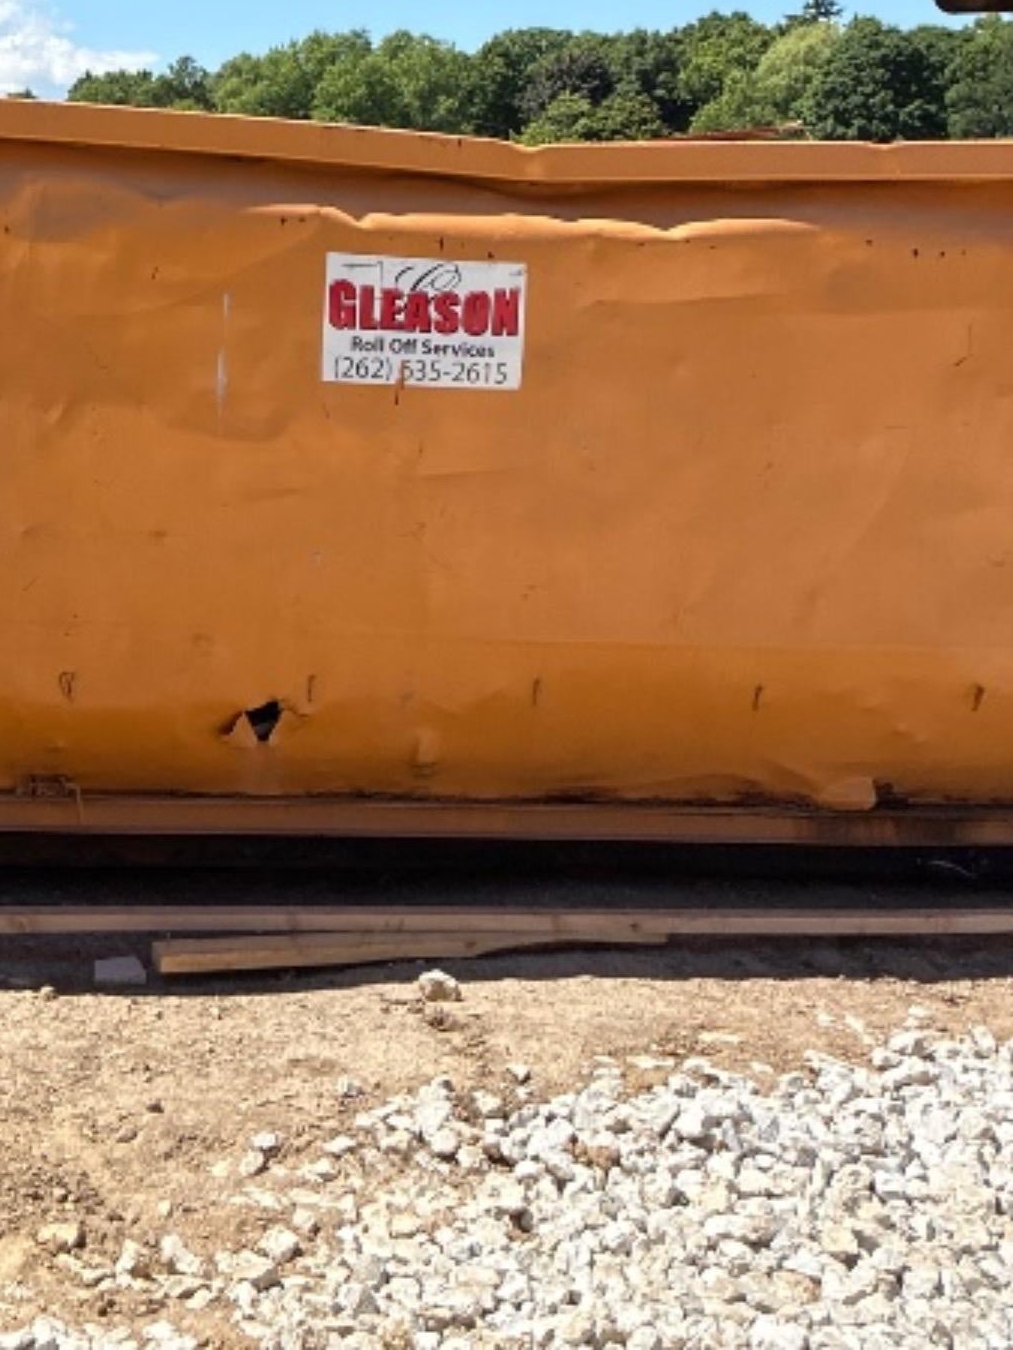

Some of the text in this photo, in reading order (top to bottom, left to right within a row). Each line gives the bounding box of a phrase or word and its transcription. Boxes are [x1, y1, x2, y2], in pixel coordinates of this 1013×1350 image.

[329, 278, 521, 337] GLEASON
[351, 335, 495, 358] Roll Off Services
[334, 356, 392, 382] (262)
